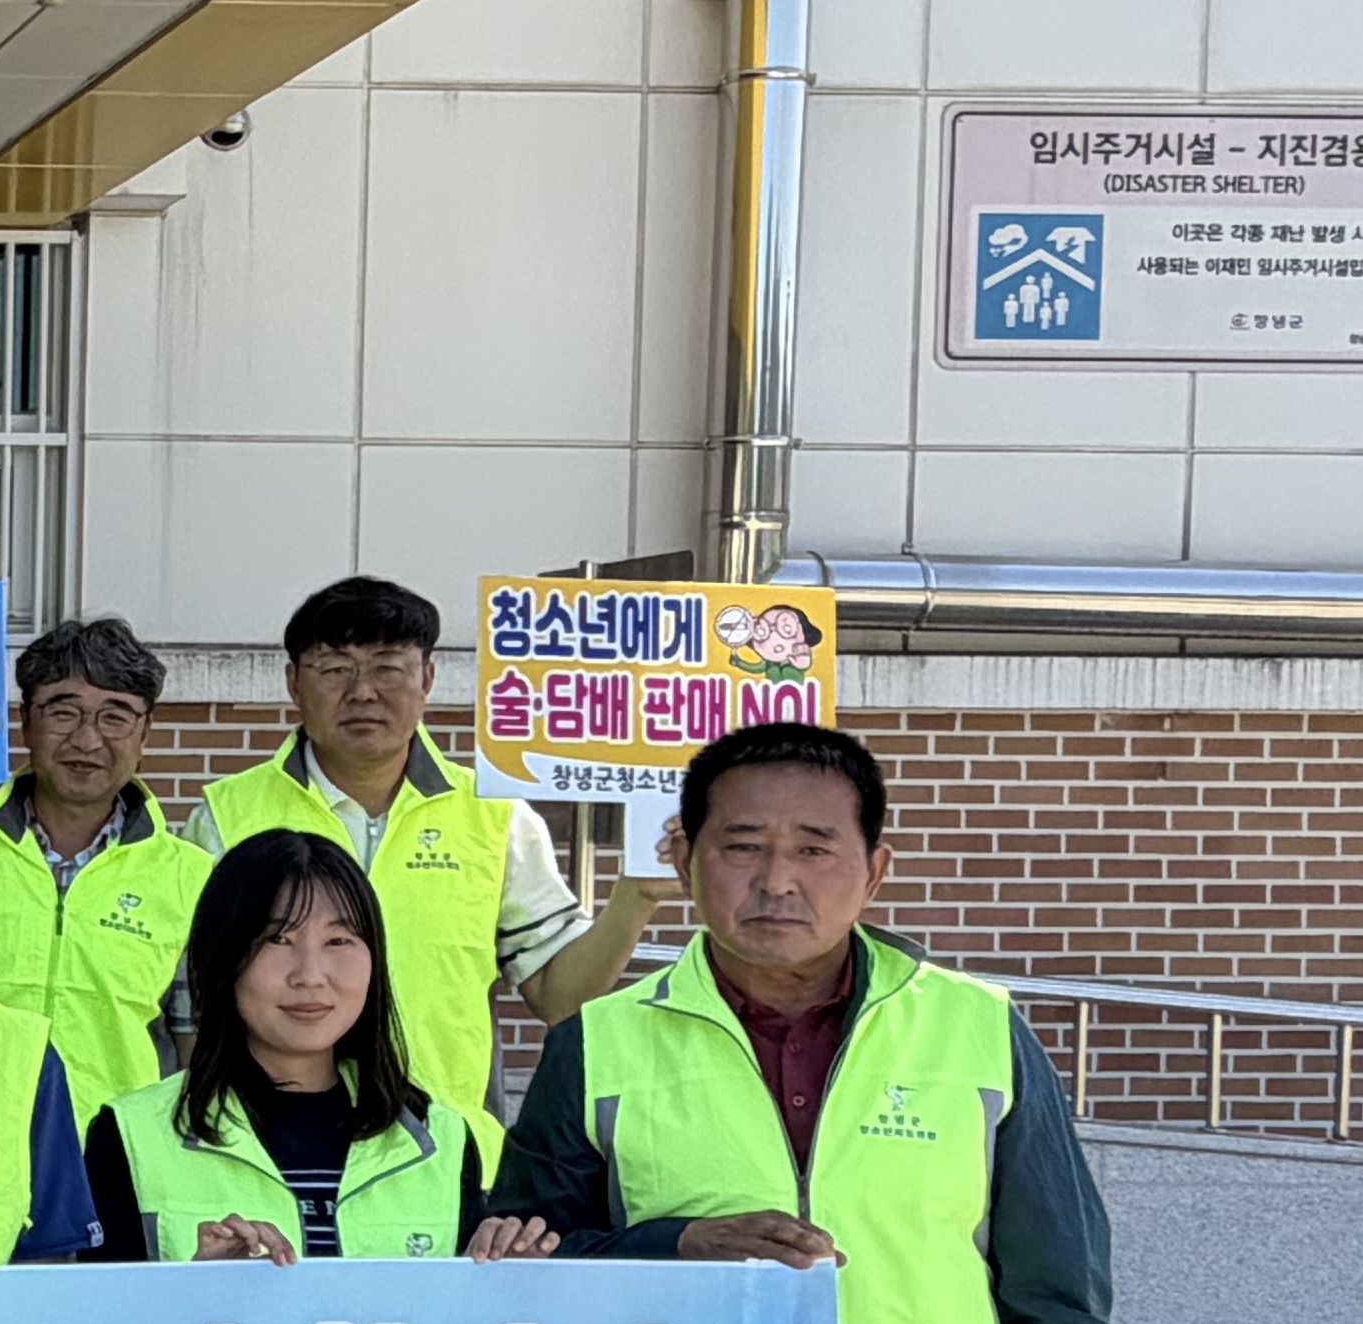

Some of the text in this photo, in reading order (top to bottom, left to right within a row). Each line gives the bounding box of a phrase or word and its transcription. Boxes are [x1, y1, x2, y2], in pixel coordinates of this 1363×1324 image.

[1030, 131, 1216, 166] 임시주거시설
[1104, 174, 1305, 195] (DISASTER SHELTER)
[1172, 223, 1223, 242] 이곳은
[1230, 224, 1264, 243] 각종
[1271, 225, 1304, 243] 재난
[1312, 225, 1345, 243] 발생
[1137, 257, 1199, 276] 사용되는
[1205, 257, 1251, 276] 이재인
[491, 590, 704, 663] 청소년에게
[490, 671, 629, 741] 술·담배
[643, 676, 728, 744] 판매
[552, 764, 683, 794] 창녕군청소년
